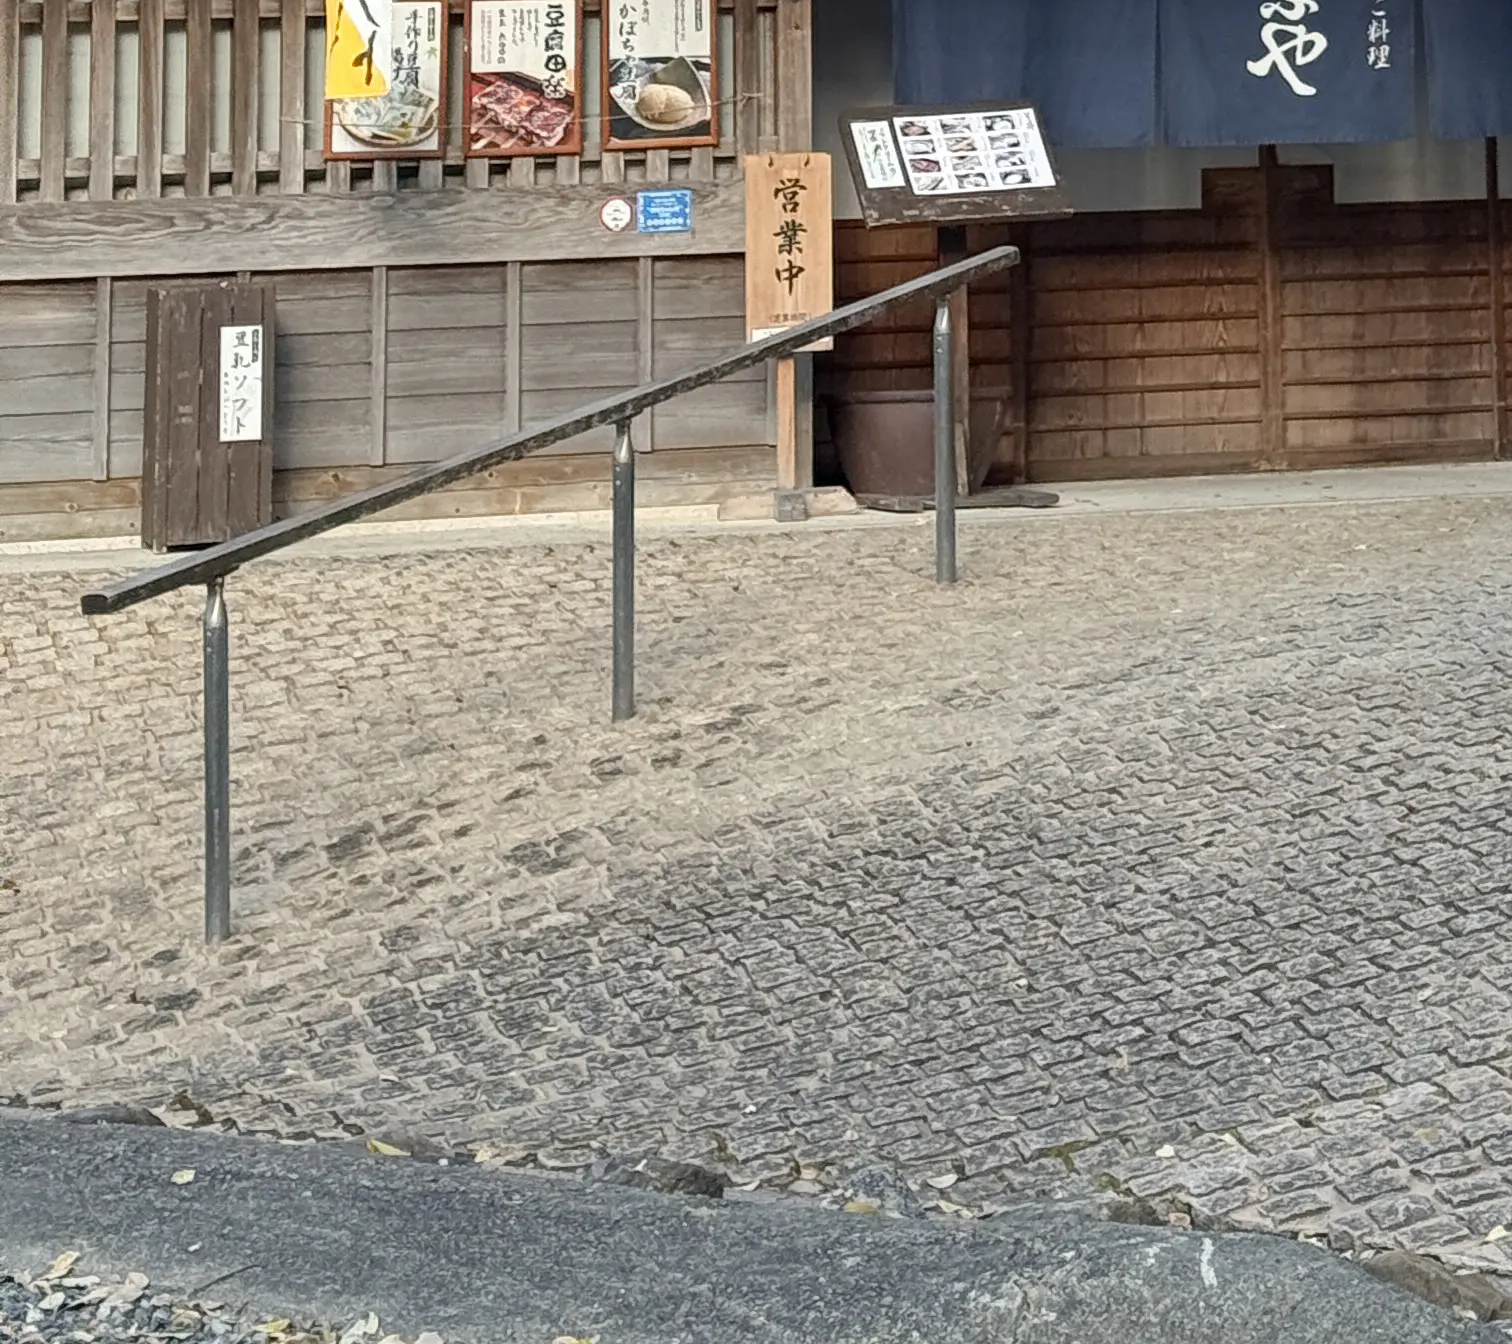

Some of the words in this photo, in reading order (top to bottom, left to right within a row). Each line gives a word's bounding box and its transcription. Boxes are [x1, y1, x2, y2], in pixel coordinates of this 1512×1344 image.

[772, 178, 809, 296] 営業中
[231, 330, 251, 434] 豆乳ソフト
